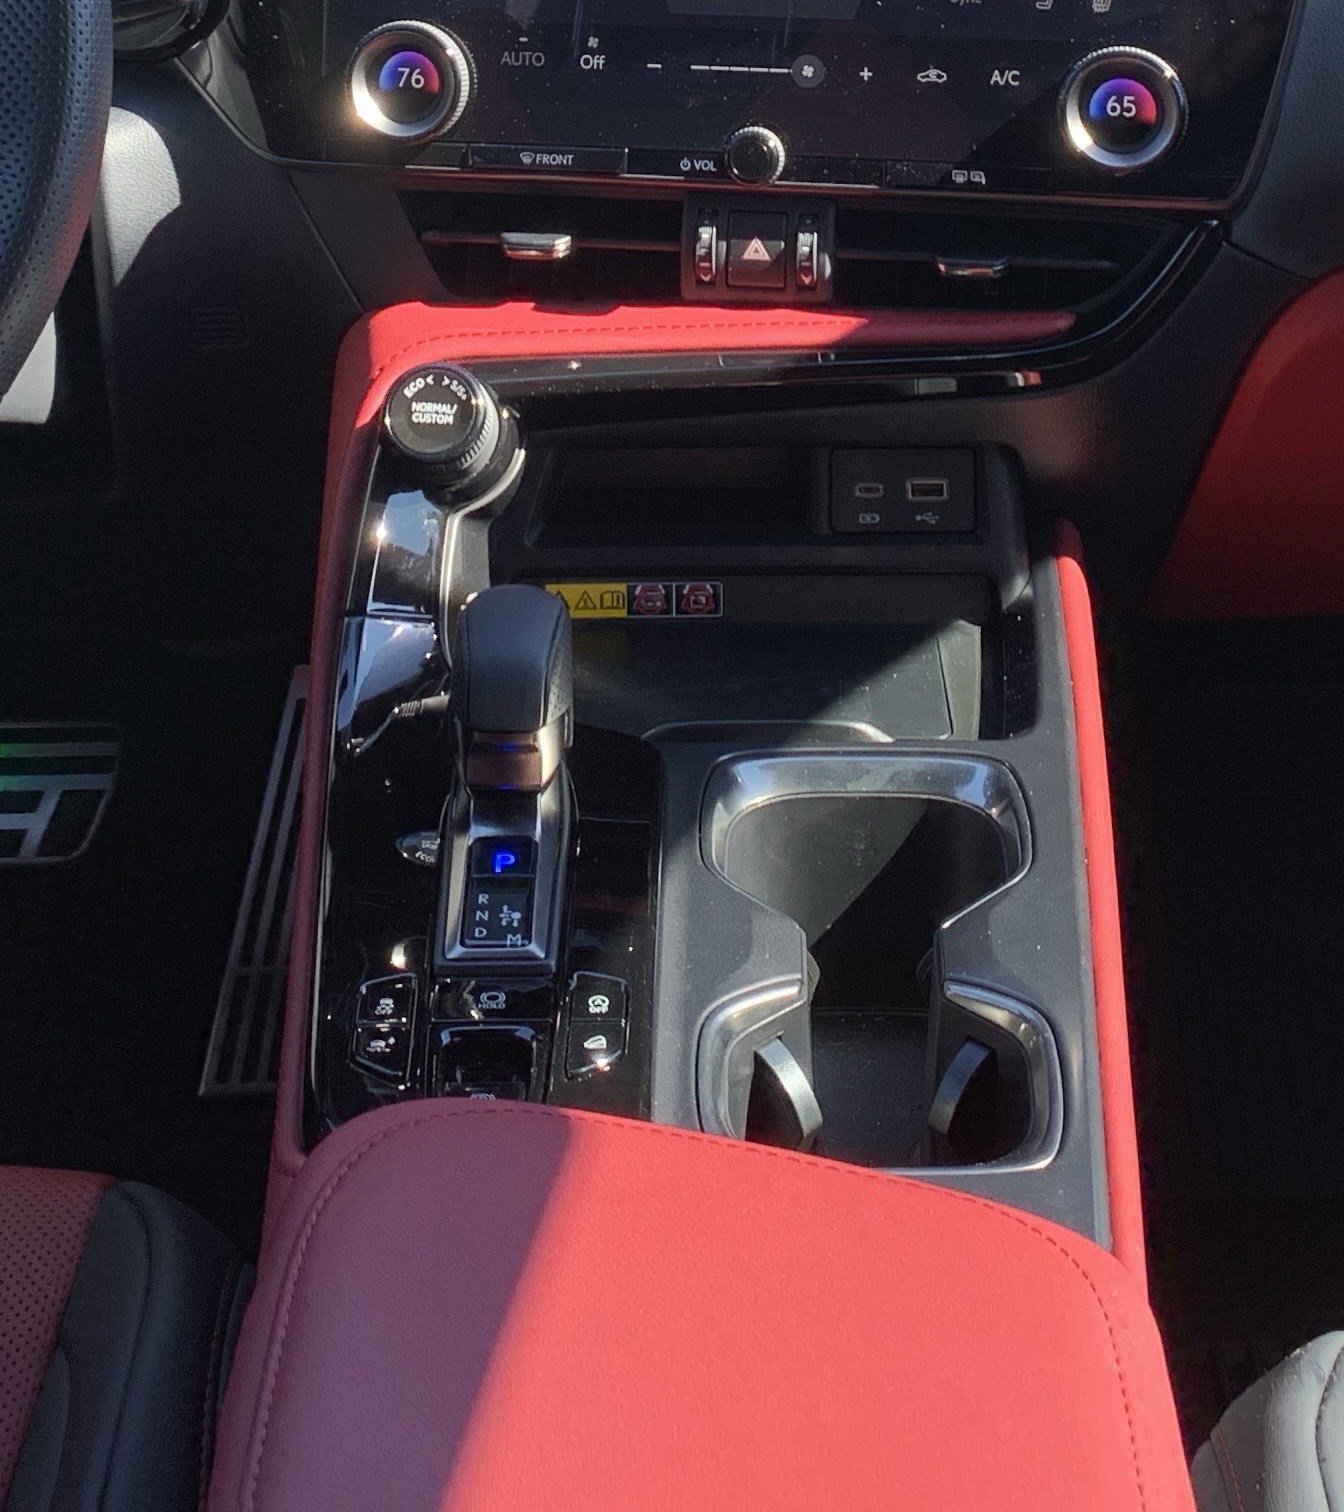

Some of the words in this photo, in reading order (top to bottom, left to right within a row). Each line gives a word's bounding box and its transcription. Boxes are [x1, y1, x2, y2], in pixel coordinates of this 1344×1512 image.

[500, 51, 545, 67] AUTO
[579, 54, 606, 70] Off
[989, 70, 1020, 86] A/C
[397, 67, 425, 89] 76
[1105, 95, 1137, 118] 65
[535, 153, 573, 166] FRONT
[693, 158, 717, 172] VOL
[403, 377, 426, 398] ECO
[411, 401, 458, 415] NORMAL/
[411, 413, 455, 425] CUSTOM
[493, 853, 516, 874] P
[478, 893, 489, 904] R
[475, 910, 489, 921] N
[474, 927, 488, 938] D
[506, 934, 522, 947] M
